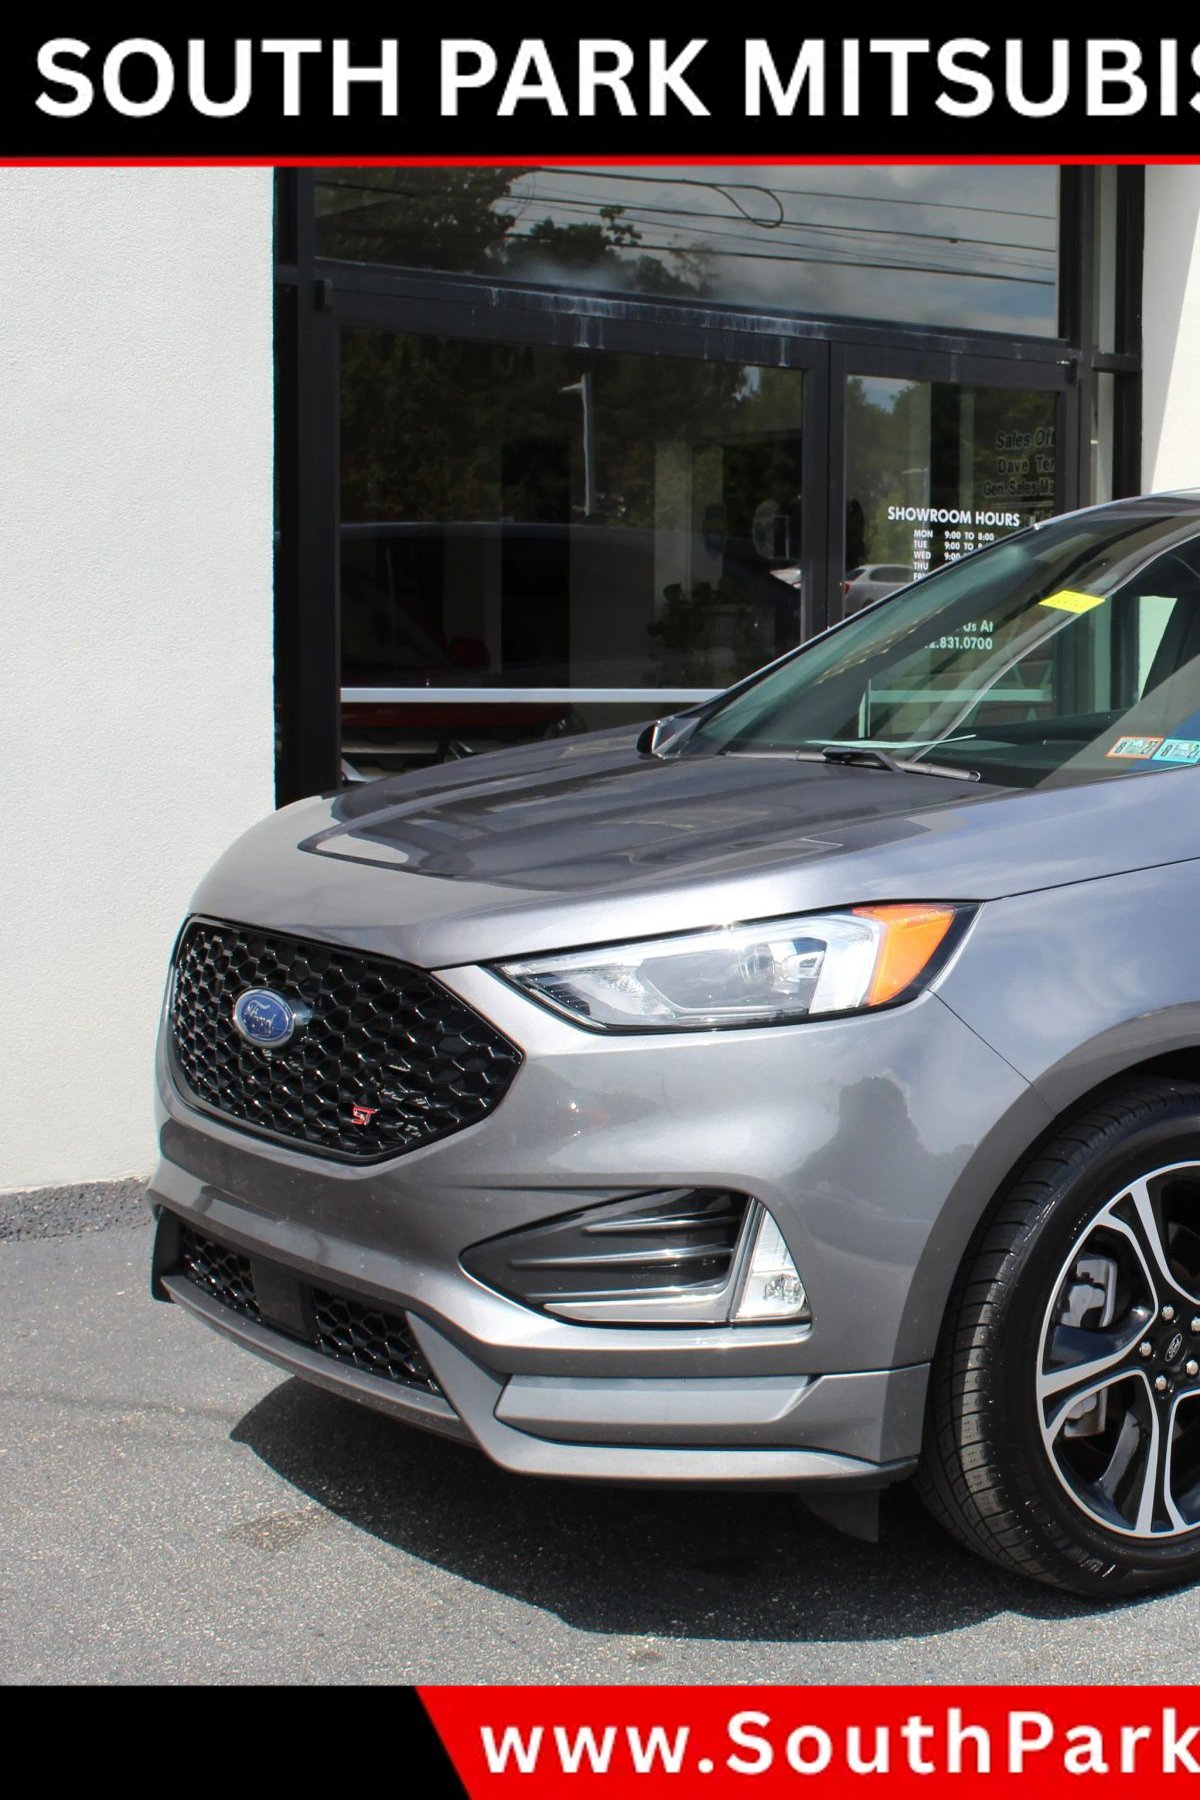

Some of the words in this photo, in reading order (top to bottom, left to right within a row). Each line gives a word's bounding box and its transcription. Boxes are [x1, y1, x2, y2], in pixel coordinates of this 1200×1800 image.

[995, 430, 1031, 450] Sales
[997, 456, 1030, 473] Dave
[1008, 480, 1038, 497] Sales
[888, 506, 972, 524] SHOWROOM
[975, 511, 1020, 527] HOURS
[913, 529, 933, 538] MON
[944, 530, 961, 540] 9:00
[964, 531, 975, 540] TO
[978, 532, 994, 541] 8:00
[913, 540, 928, 549] TUE
[944, 541, 960, 550] 9:00
[963, 542, 974, 550] TO
[913, 551, 931, 560] WED
[913, 562, 929, 570] THU
[980, 620, 993, 632] At
